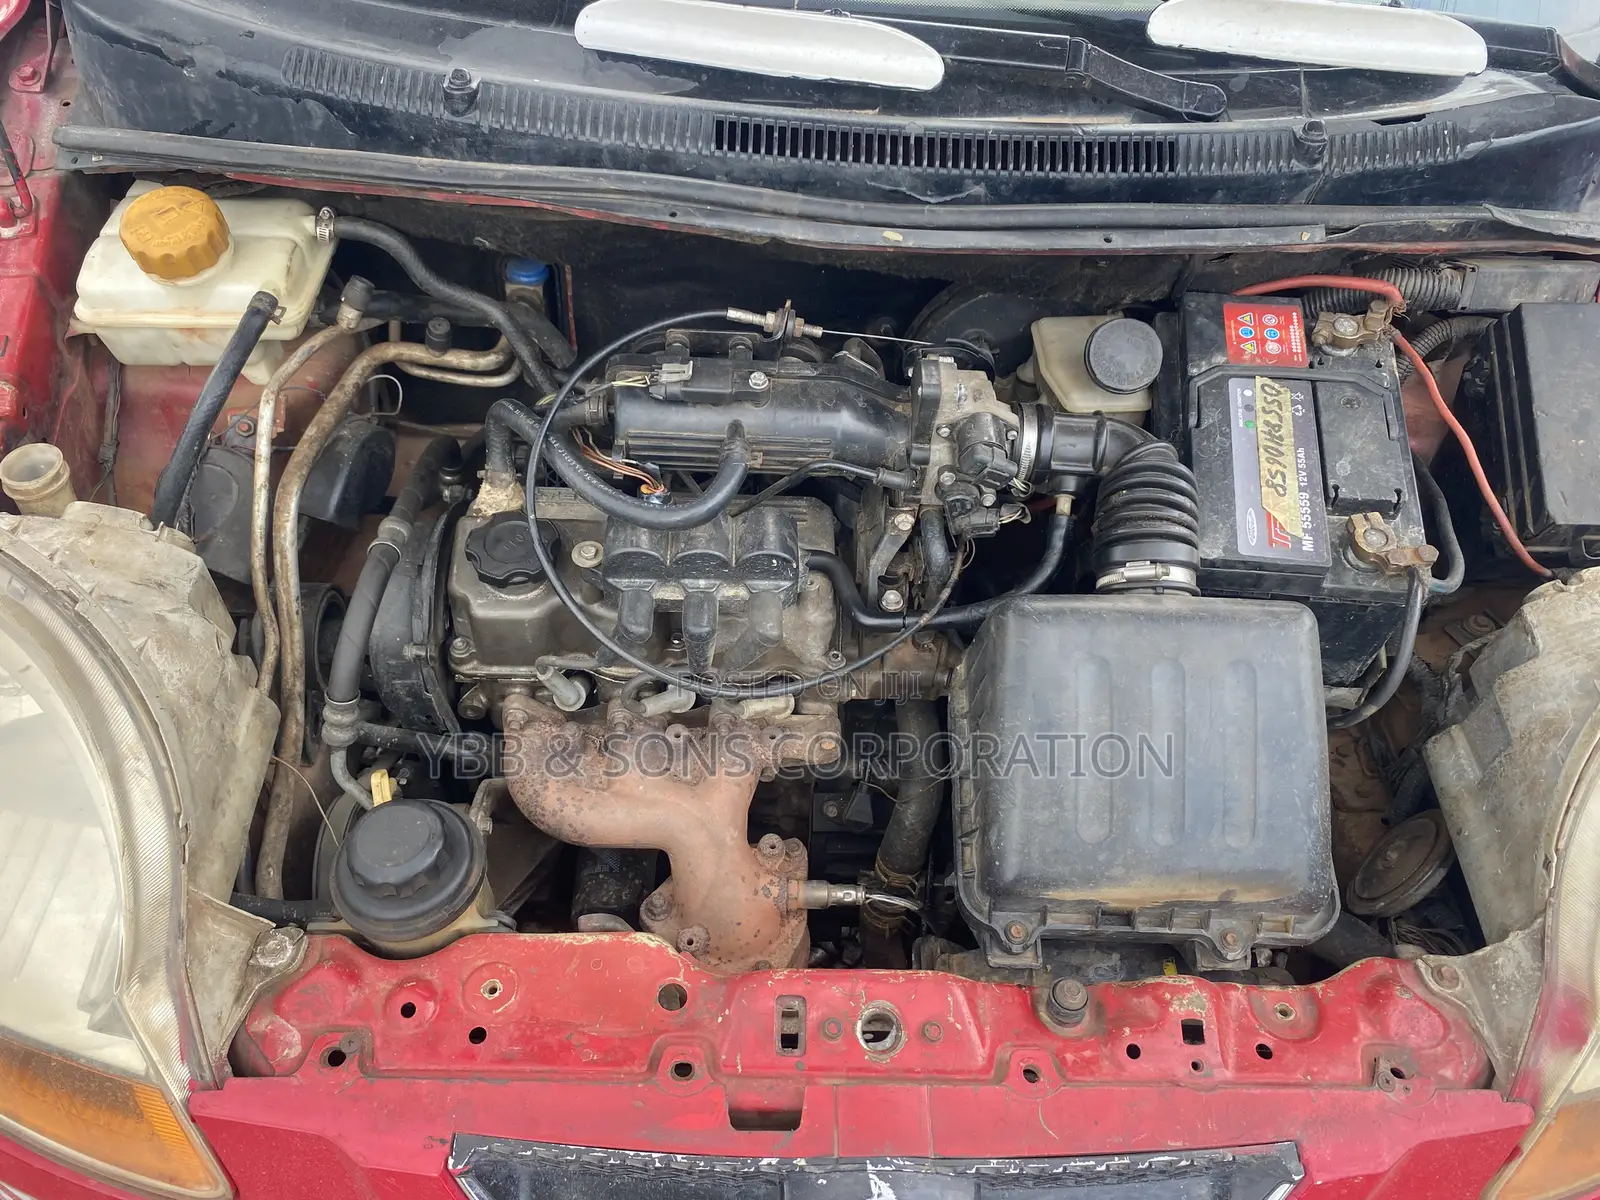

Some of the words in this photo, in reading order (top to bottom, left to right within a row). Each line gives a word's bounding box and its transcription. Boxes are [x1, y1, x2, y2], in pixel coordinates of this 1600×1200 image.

[1297, 447, 1307, 469] 55Ah
[1299, 470, 1308, 487] 12V
[1298, 491, 1312, 529] 55559
[1301, 532, 1315, 552] MF
